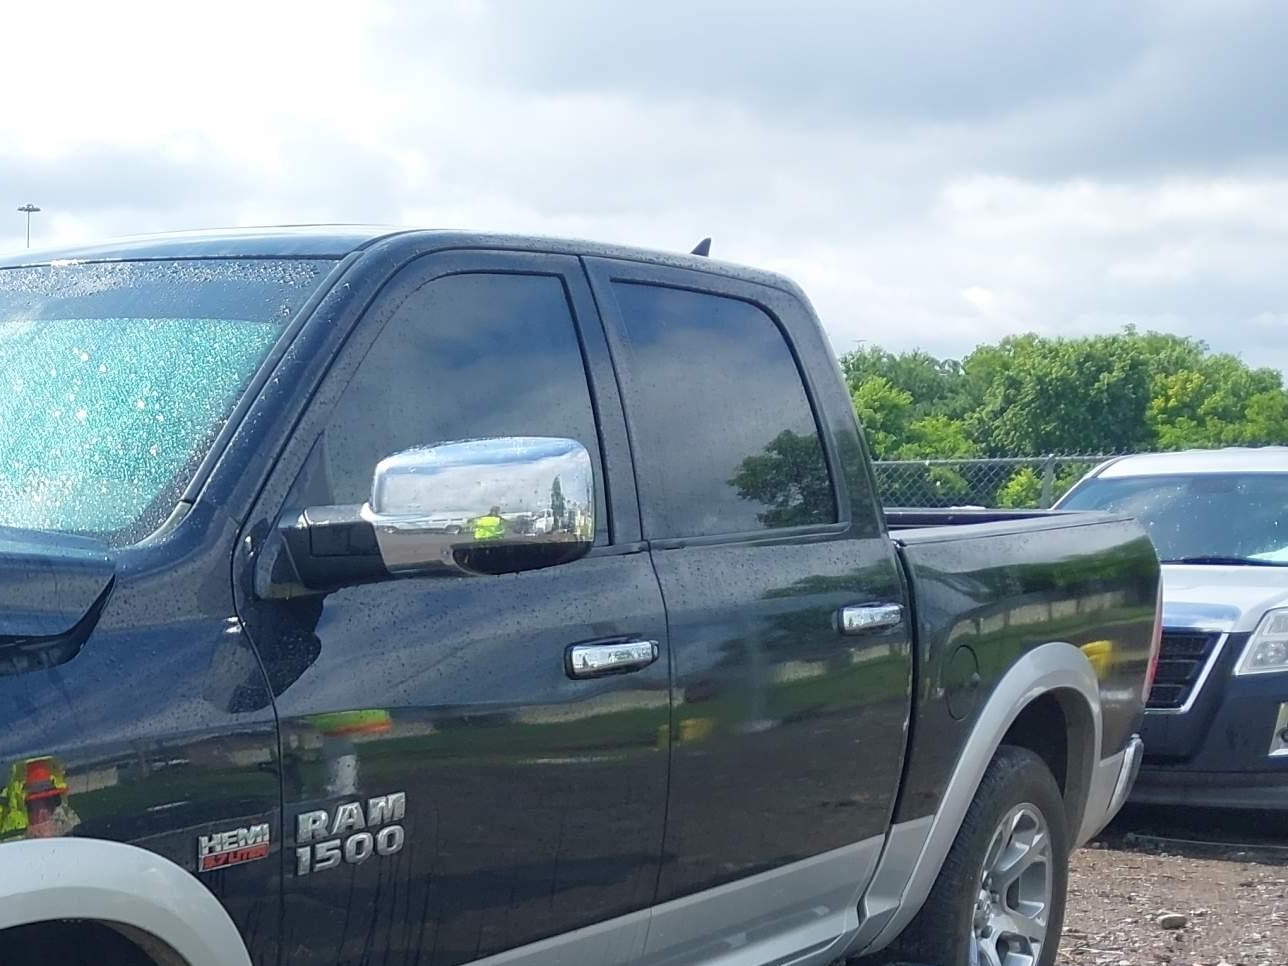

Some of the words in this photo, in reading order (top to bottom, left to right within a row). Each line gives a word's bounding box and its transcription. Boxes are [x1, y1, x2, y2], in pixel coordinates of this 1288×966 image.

[198, 823, 270, 856] HEMI
[296, 792, 406, 843] RAM
[296, 825, 405, 876] 1500
